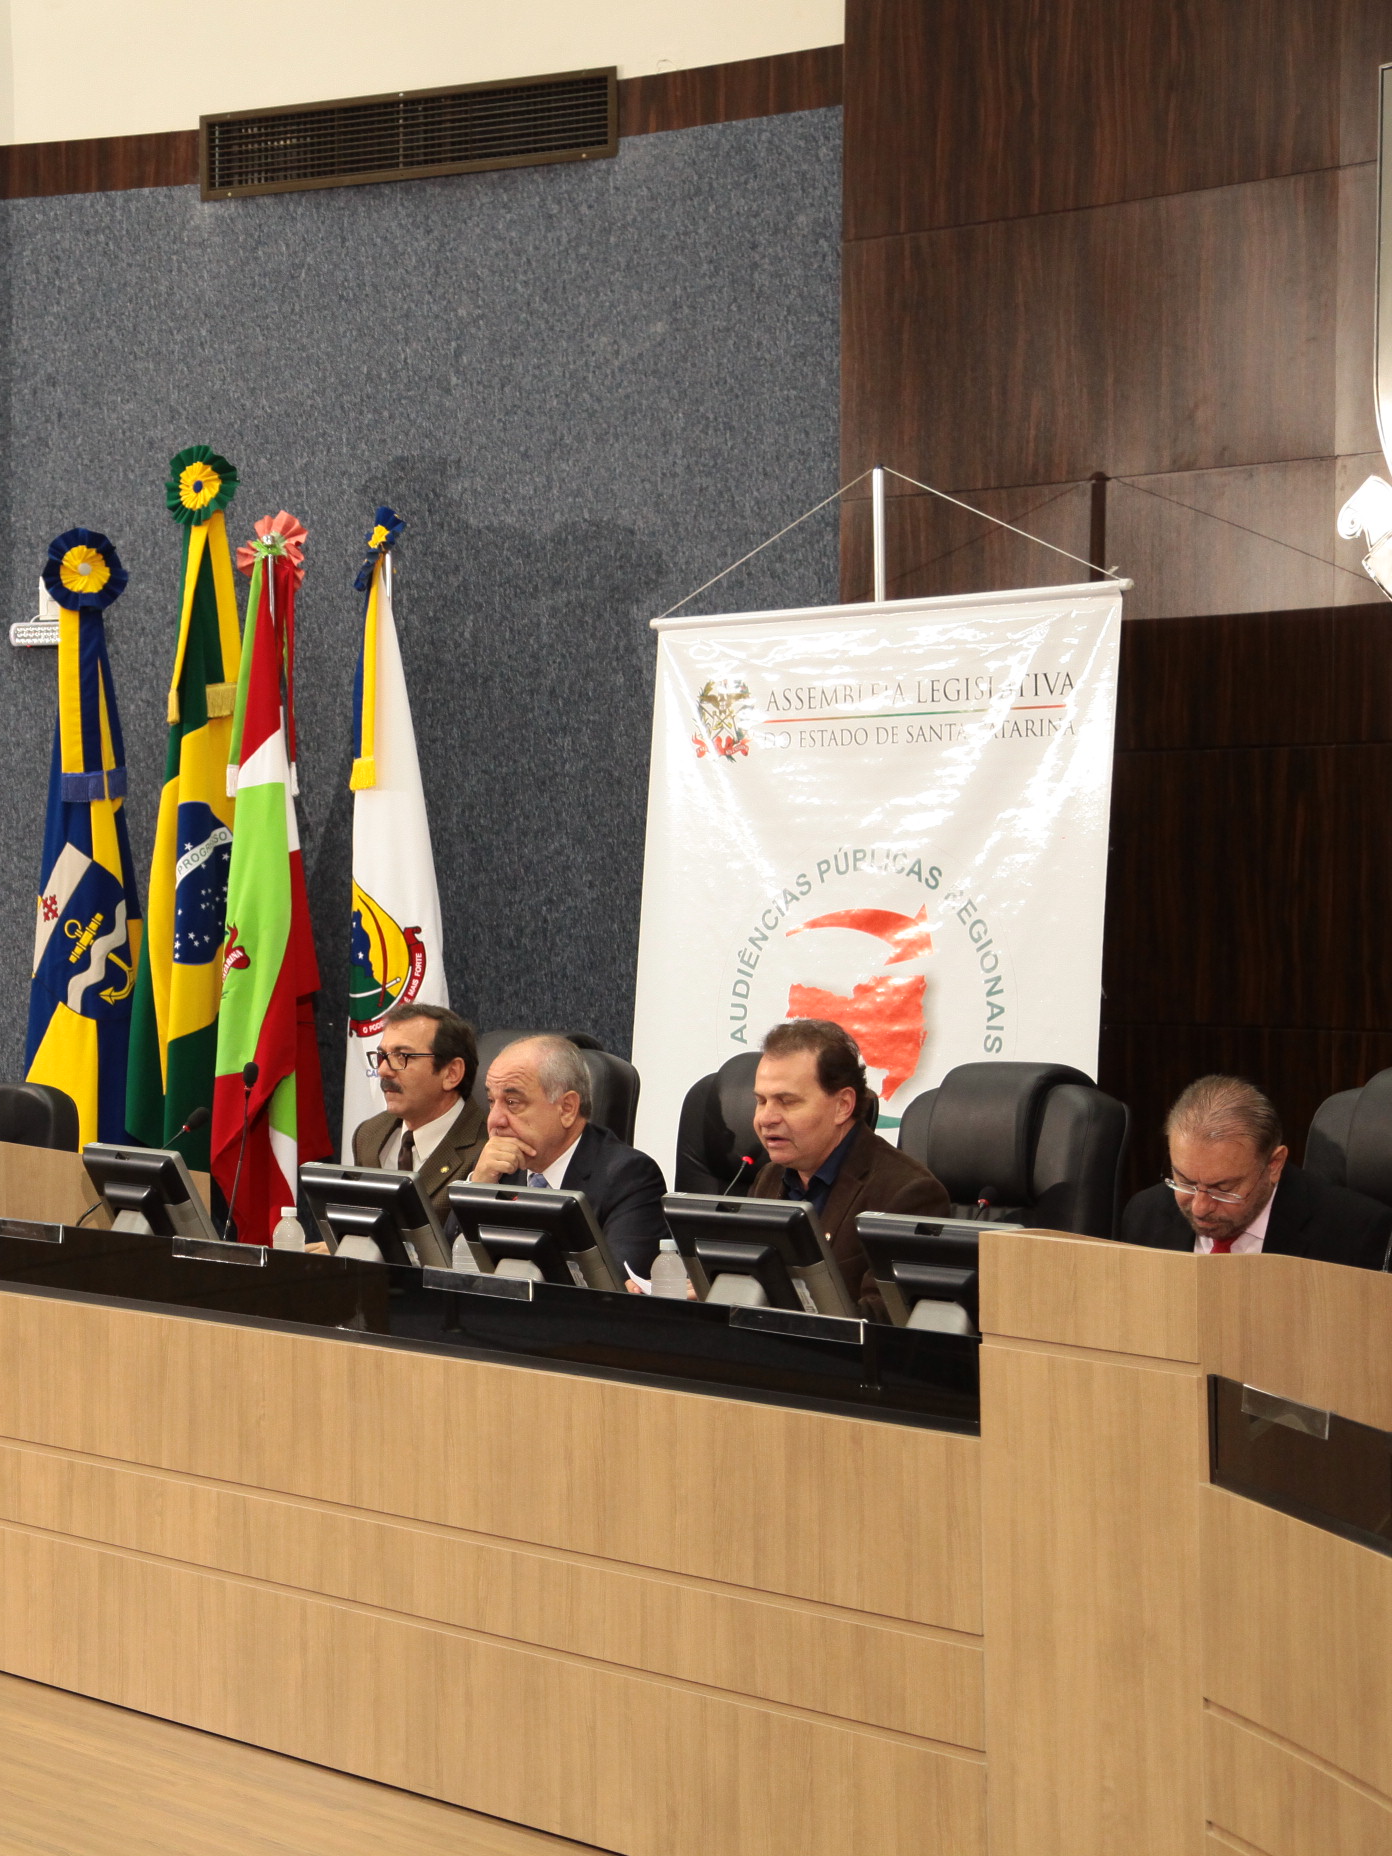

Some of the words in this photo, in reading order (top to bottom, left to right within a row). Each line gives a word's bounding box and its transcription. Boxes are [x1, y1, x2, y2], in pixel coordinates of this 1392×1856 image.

[917, 671, 1075, 704] LEGISLTIVA
[799, 727, 869, 748] ESTADO
[876, 725, 899, 746] DE
[979, 717, 1076, 740] ATARINA
[729, 873, 812, 1045] AUDIÊNCIAS
[816, 847, 943, 890] PÚBLICAS
[369, 1020, 384, 1032] PODE
[408, 979, 419, 996] MAIS
[414, 952, 422, 976] FORTE
